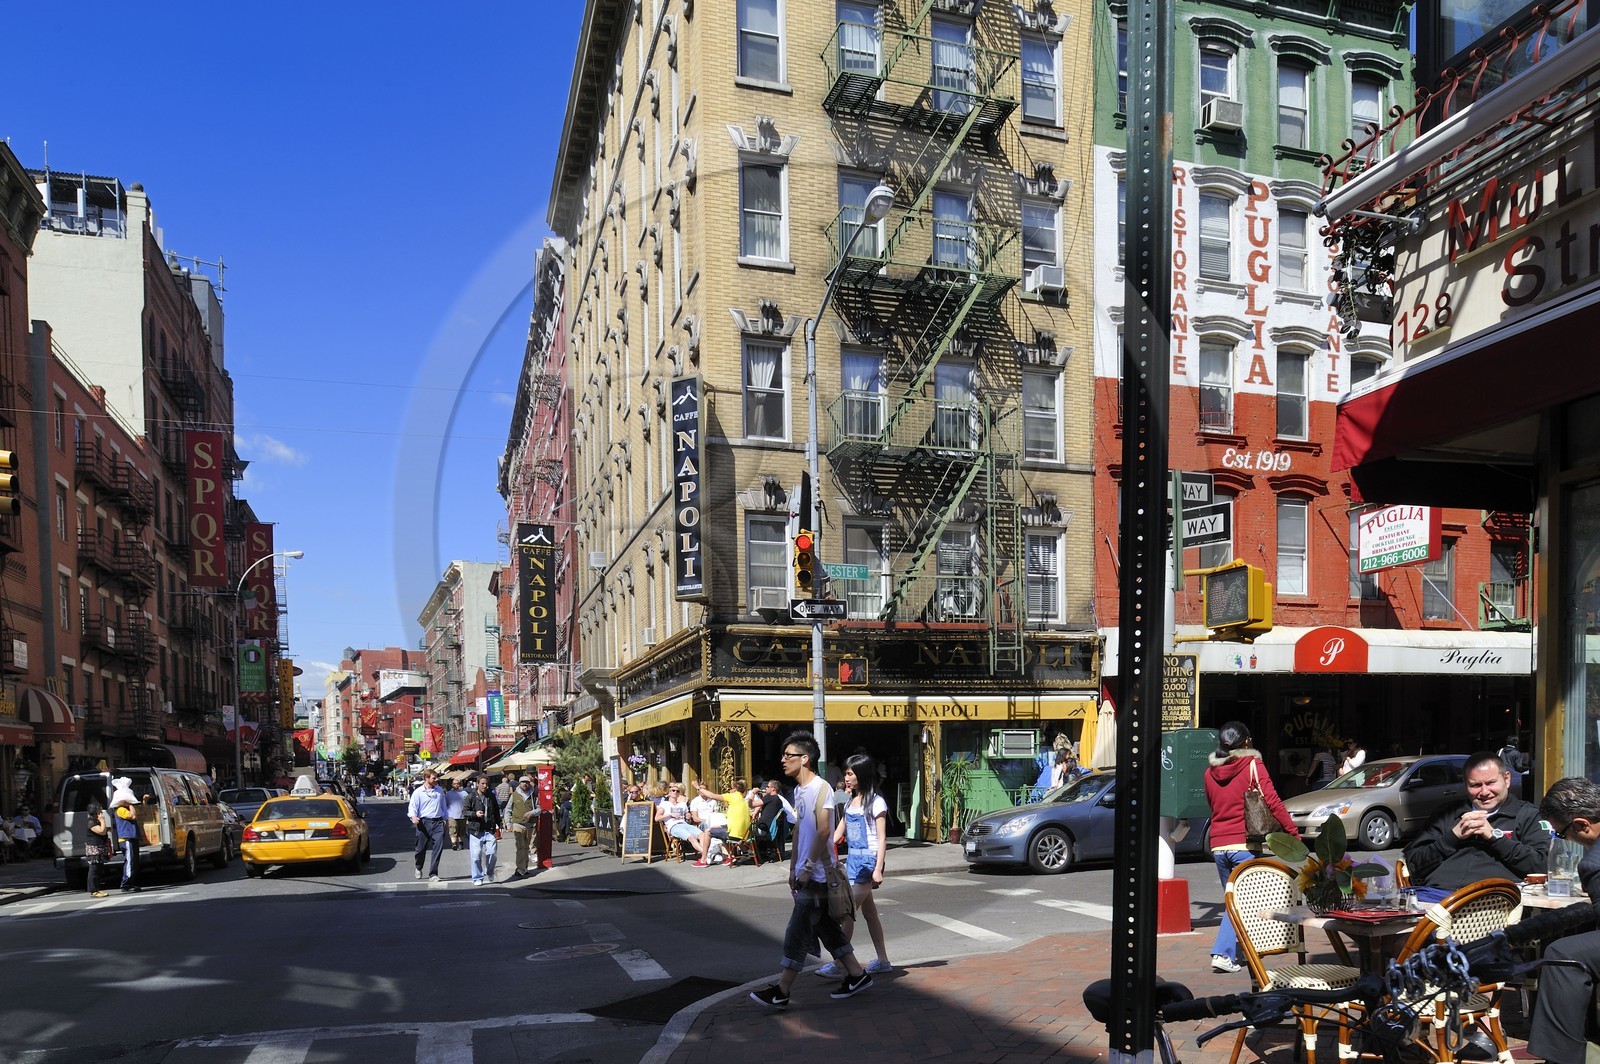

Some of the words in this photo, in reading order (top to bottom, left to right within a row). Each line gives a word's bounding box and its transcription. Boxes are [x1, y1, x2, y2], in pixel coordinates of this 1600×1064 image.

[1448, 119, 1600, 262] MUL
[1171, 165, 1188, 376] RISTORANTE
[1243, 181, 1274, 387] PUGLIA
[1397, 293, 1452, 344] 128
[673, 411, 699, 422] CAFFE
[1222, 448, 1253, 470] Est.
[1255, 449, 1292, 471] 1919
[676, 429, 700, 578] NAPOLI
[1187, 516, 1218, 535] WAY
[1366, 506, 1424, 535] PUGLIA
[1372, 537, 1396, 549] COCKTAIL
[1396, 534, 1416, 544] LOUNGE
[1378, 529, 1410, 541] RESTAURANT
[522, 547, 551, 556] CAFFE
[1371, 544, 1401, 555] BRICK-OVEN
[1401, 540, 1417, 549] PIZZA
[1363, 546, 1427, 570] 212-966-6006
[528, 557, 548, 651] NAPOLI
[799, 605, 816, 613] ONE
[822, 605, 842, 614] WAY
[1319, 637, 1345, 666] P
[1440, 649, 1502, 671] Puglia
[777, 667, 798, 675] Luigi
[1163, 656, 1179, 667] NO
[1163, 667, 1193, 677] MPING
[1163, 683, 1187, 691] 0,000
[857, 704, 913, 718] CAFFE
[918, 704, 979, 718] NAPOLI
